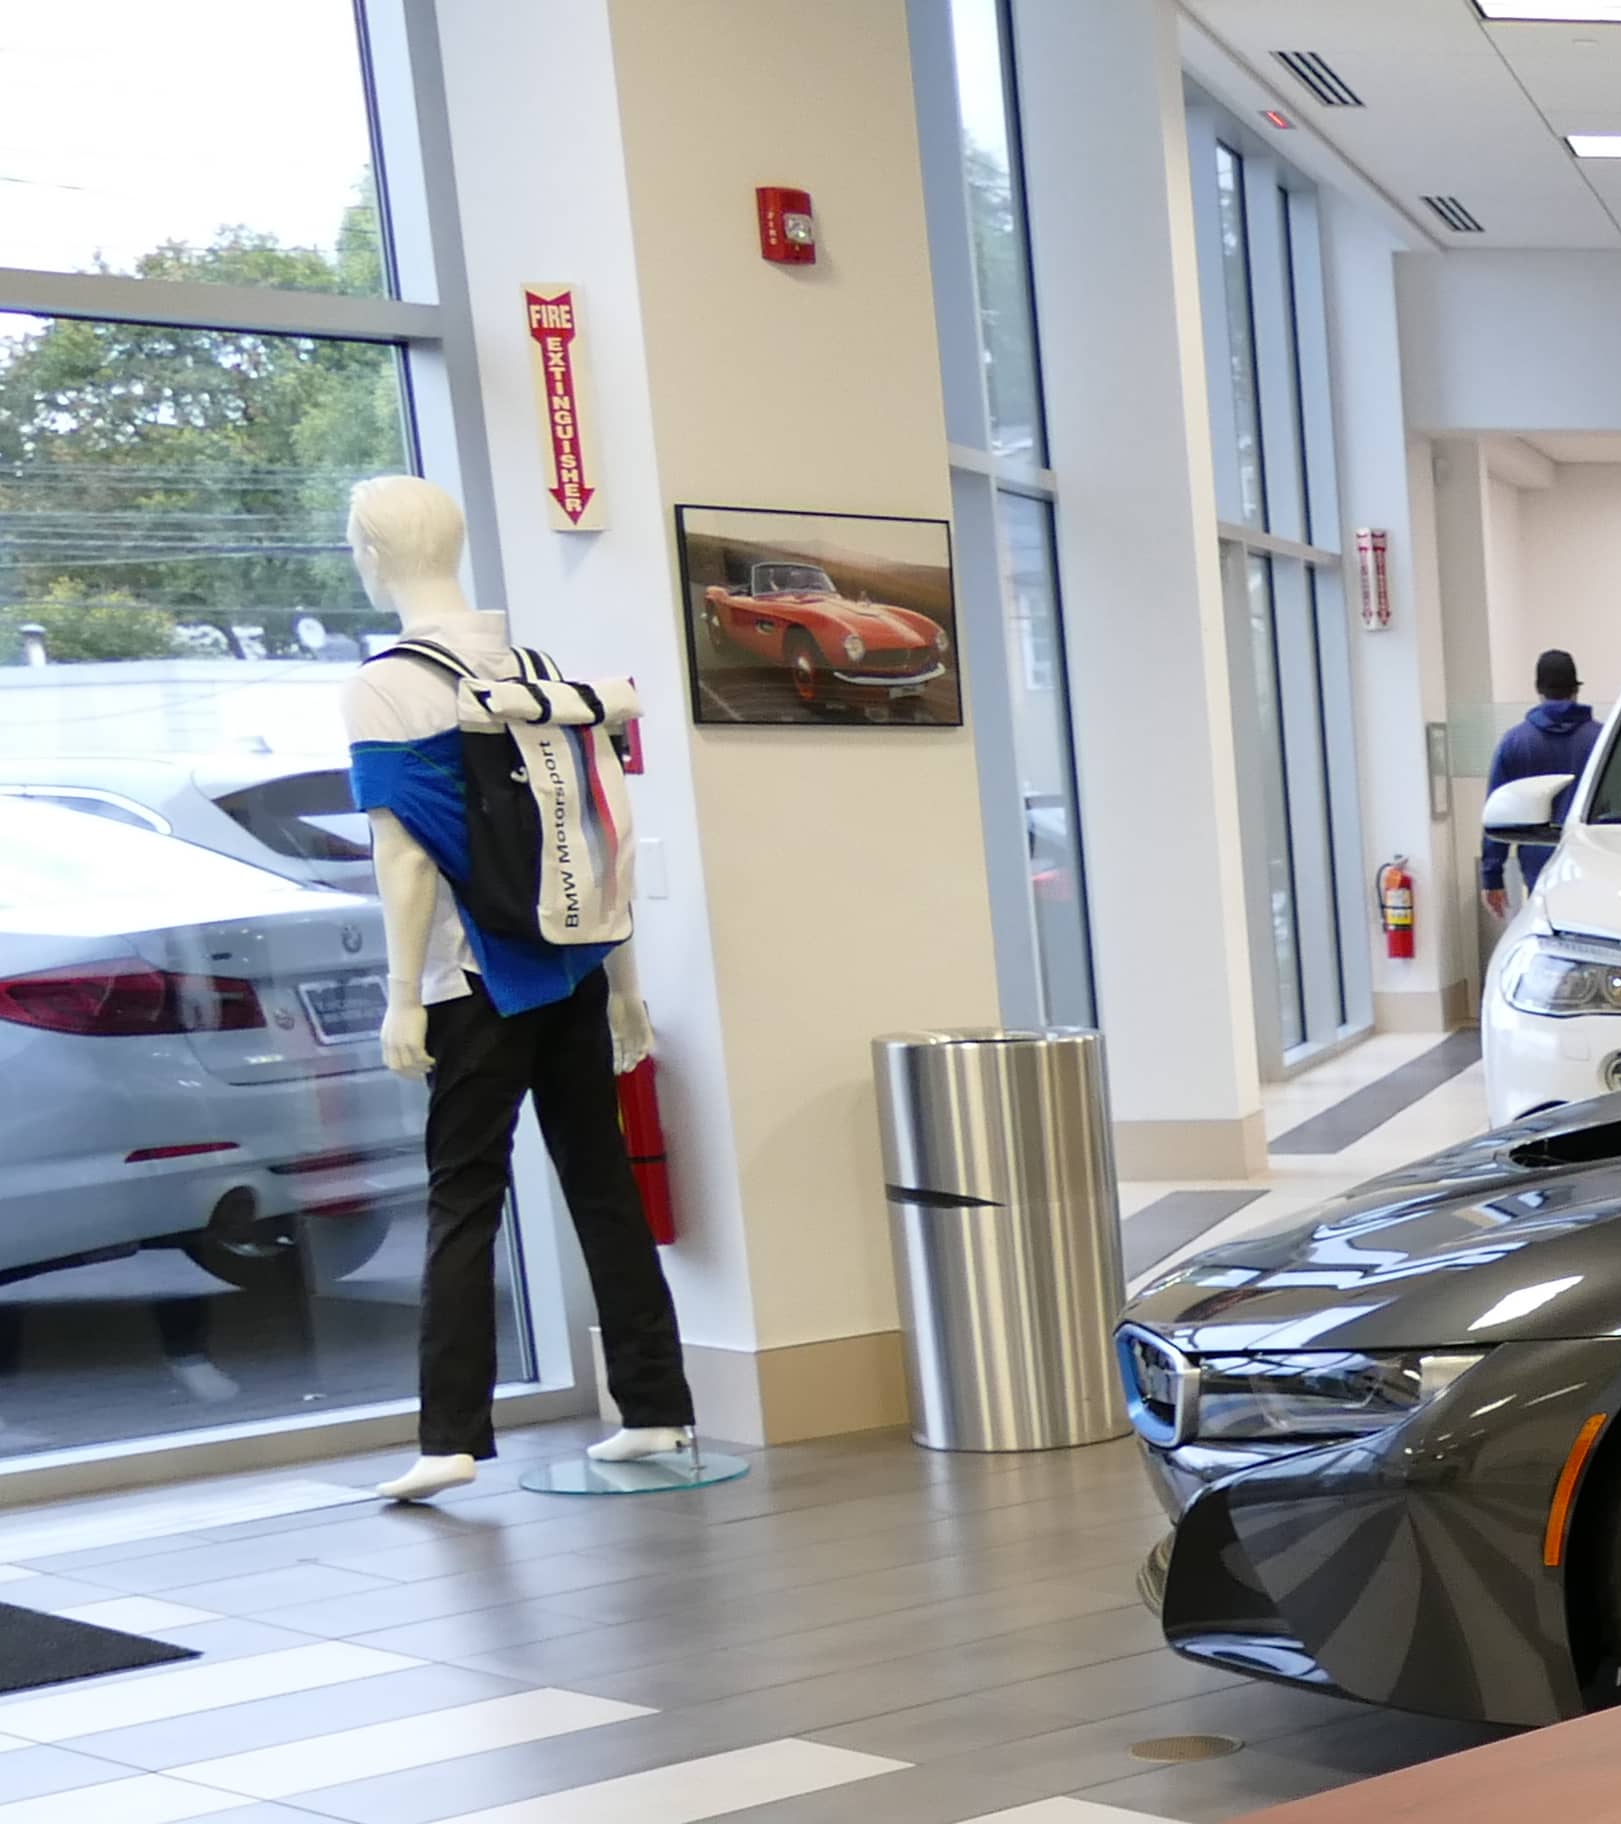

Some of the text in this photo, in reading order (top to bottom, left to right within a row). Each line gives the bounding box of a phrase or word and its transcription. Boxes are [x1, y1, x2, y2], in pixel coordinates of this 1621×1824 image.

[528, 304, 573, 329] FIRE
[546, 336, 582, 512] EXTINGUISHER
[538, 739, 580, 929] BMW Motorsport
